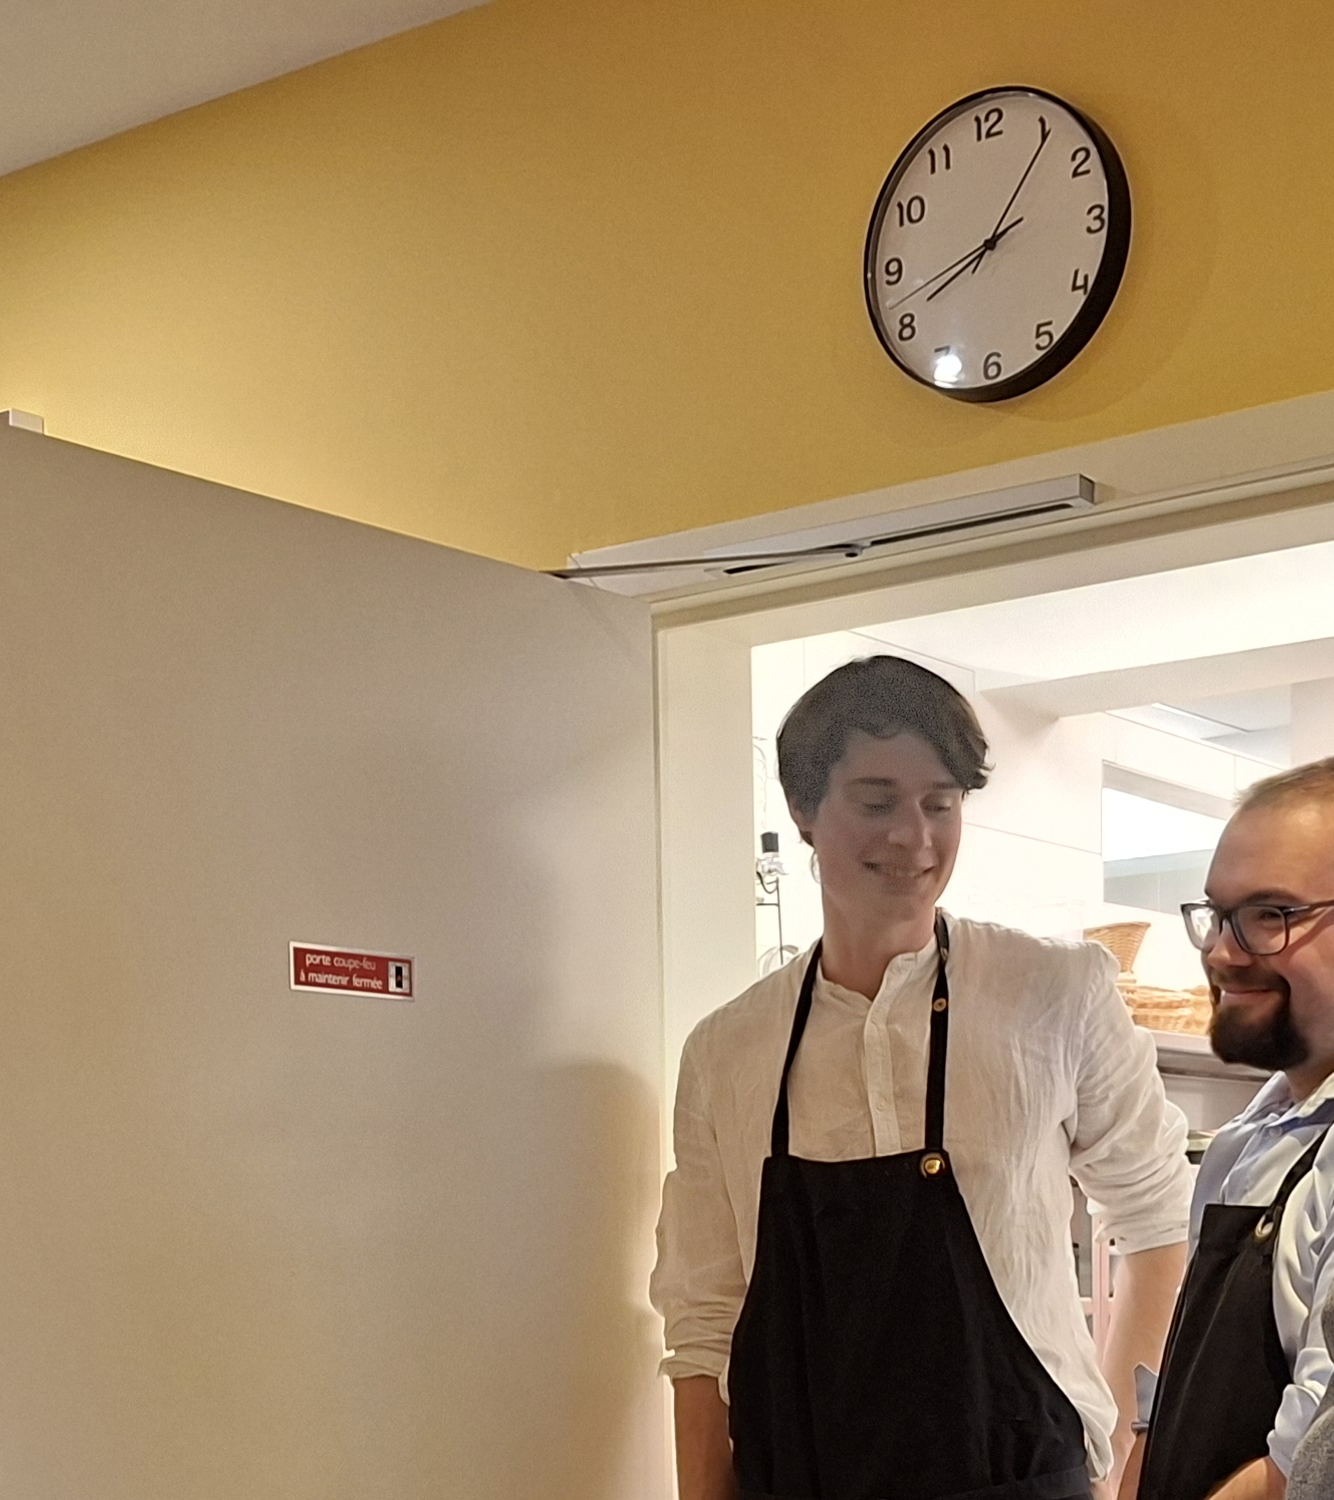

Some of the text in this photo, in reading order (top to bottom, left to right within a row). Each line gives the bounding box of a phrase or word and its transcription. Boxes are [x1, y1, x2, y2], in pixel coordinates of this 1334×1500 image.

[974, 107, 1004, 142] 12
[1038, 115, 1048, 144] 1
[927, 143, 951, 175] 11
[1070, 146, 1091, 178] 2
[897, 195, 925, 227] 10
[1085, 204, 1105, 234] 3
[884, 257, 903, 286] 9
[1071, 268, 1089, 295] 4
[898, 312, 916, 342] 8
[1034, 320, 1054, 351] 5
[982, 351, 1002, 381] 6
[305, 953, 376, 971] porte coupe-feu
[308, 970, 349, 984] maintenir
[352, 973, 383, 990] fermée
